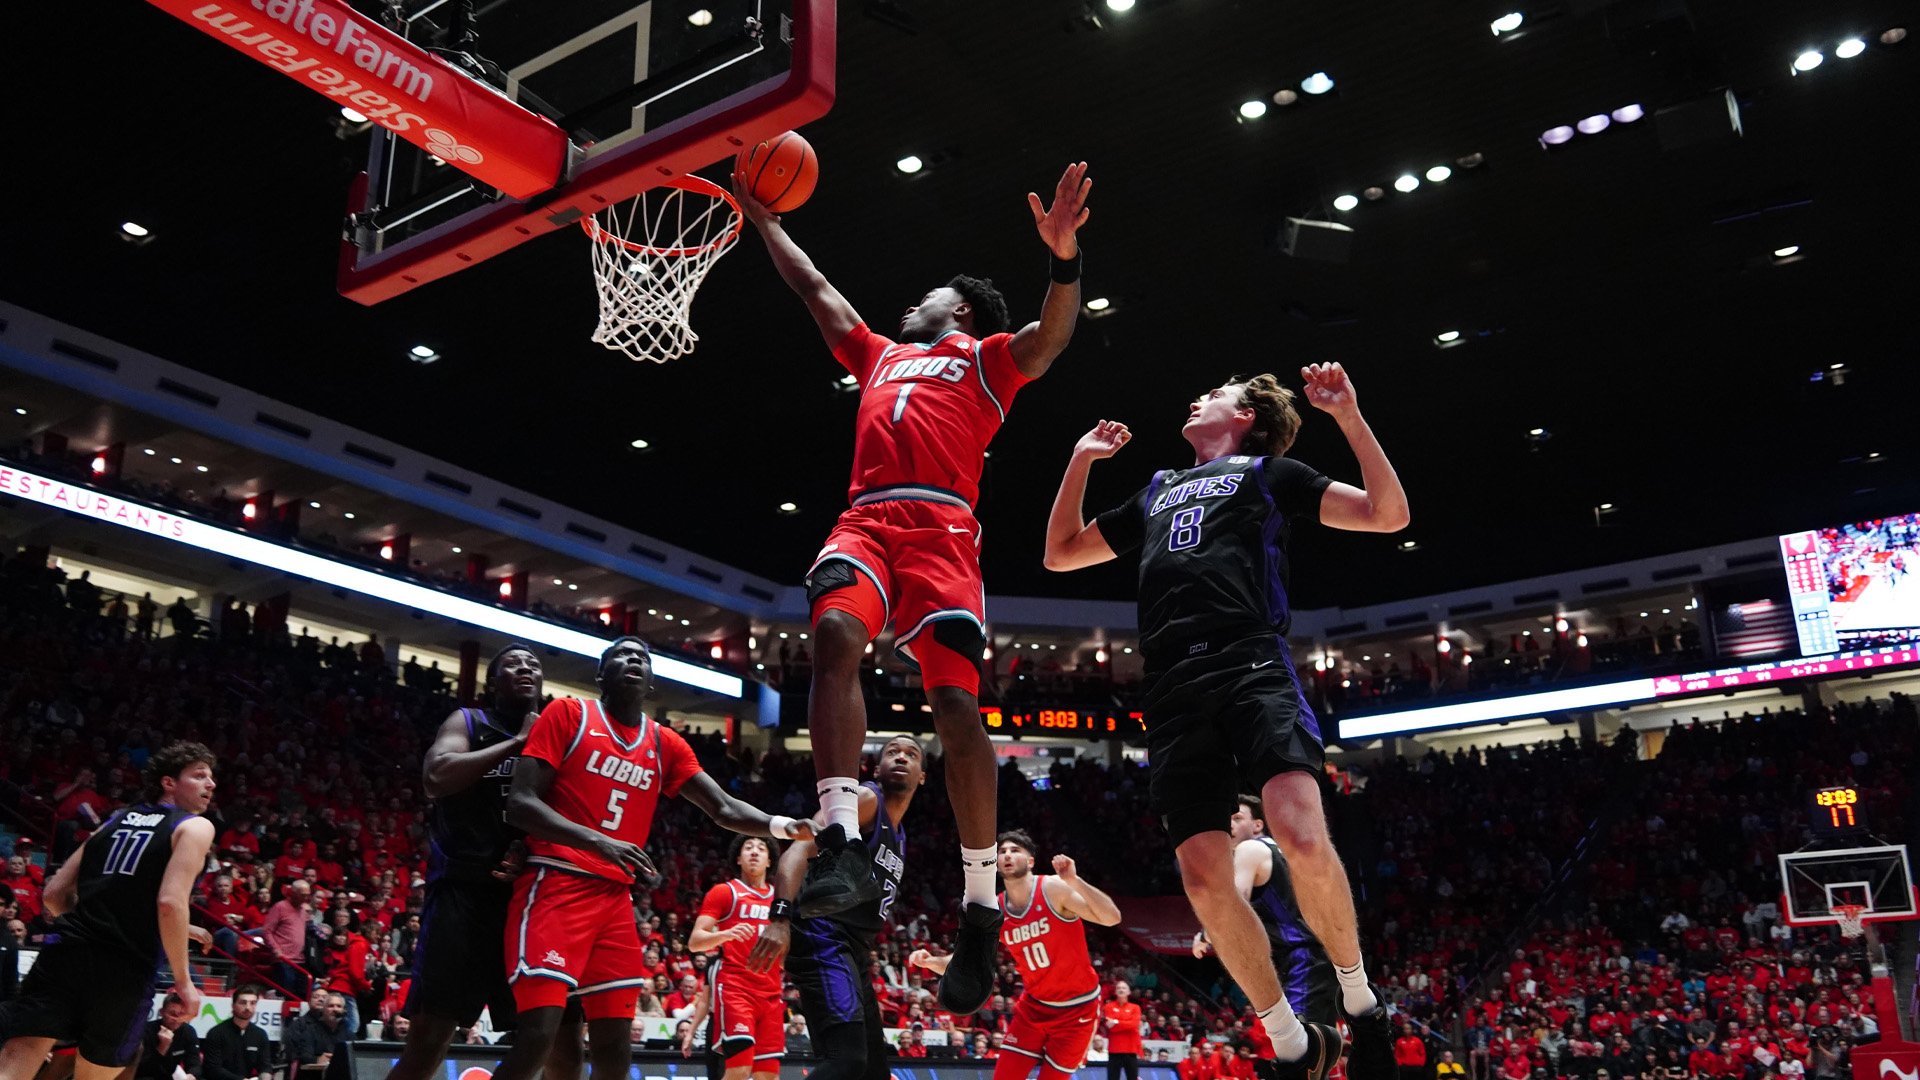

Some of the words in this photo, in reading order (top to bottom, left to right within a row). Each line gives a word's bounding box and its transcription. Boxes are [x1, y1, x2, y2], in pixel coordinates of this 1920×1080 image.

[873, 356, 972, 389] LOBOS
[892, 382, 917, 422] 1
[1150, 473, 1245, 516] LOPES
[1168, 505, 1204, 552] 8
[1039, 710, 1078, 728] 13:03
[1106, 717, 1116, 731] 3
[585, 750, 655, 791] LOBOS
[600, 788, 628, 831] 5
[1816, 788, 1857, 806] 13:03
[1830, 804, 1855, 827] 17
[103, 829, 154, 875] 11
[739, 903, 770, 920] LOB
[879, 878, 897, 921] 2
[1004, 916, 1051, 945] LOBOS
[1022, 941, 1051, 972] 10
